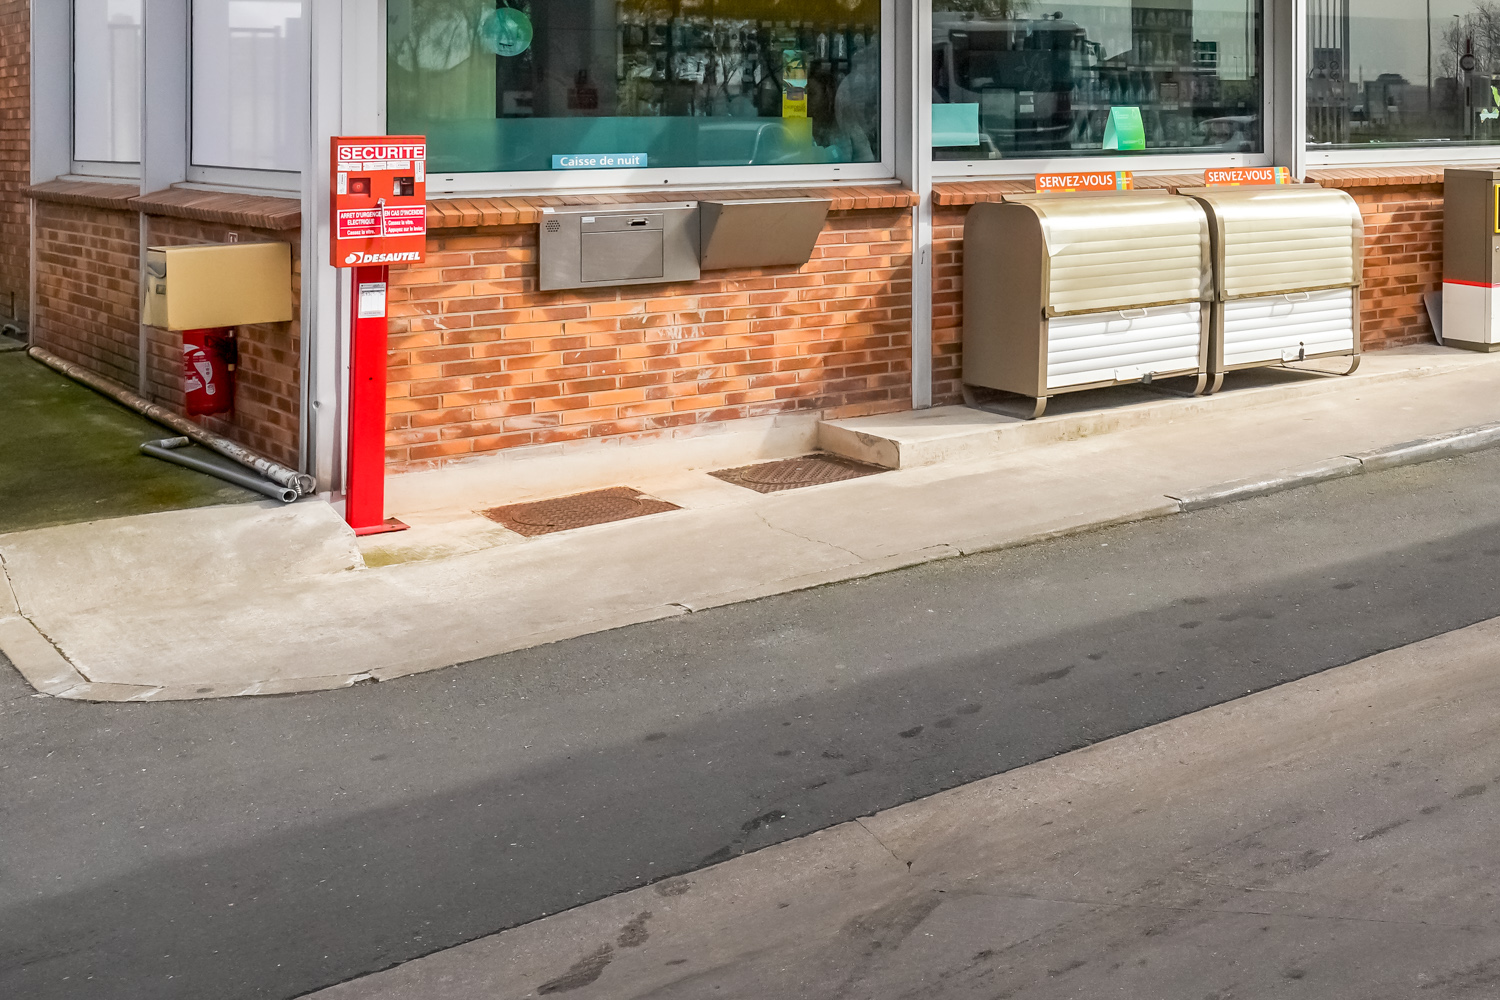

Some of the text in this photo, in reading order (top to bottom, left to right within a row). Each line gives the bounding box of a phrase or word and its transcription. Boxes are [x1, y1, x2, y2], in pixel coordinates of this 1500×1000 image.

[340, 146, 424, 159] SECURITE
[560, 155, 640, 167] Caisse de nuit
[1039, 174, 1113, 188] SERVEZ-VOUS
[1208, 169, 1272, 182] SERVEZ-VOUS
[347, 218, 375, 226] ELECTRIQUE
[363, 251, 421, 264] DESAUTEL
